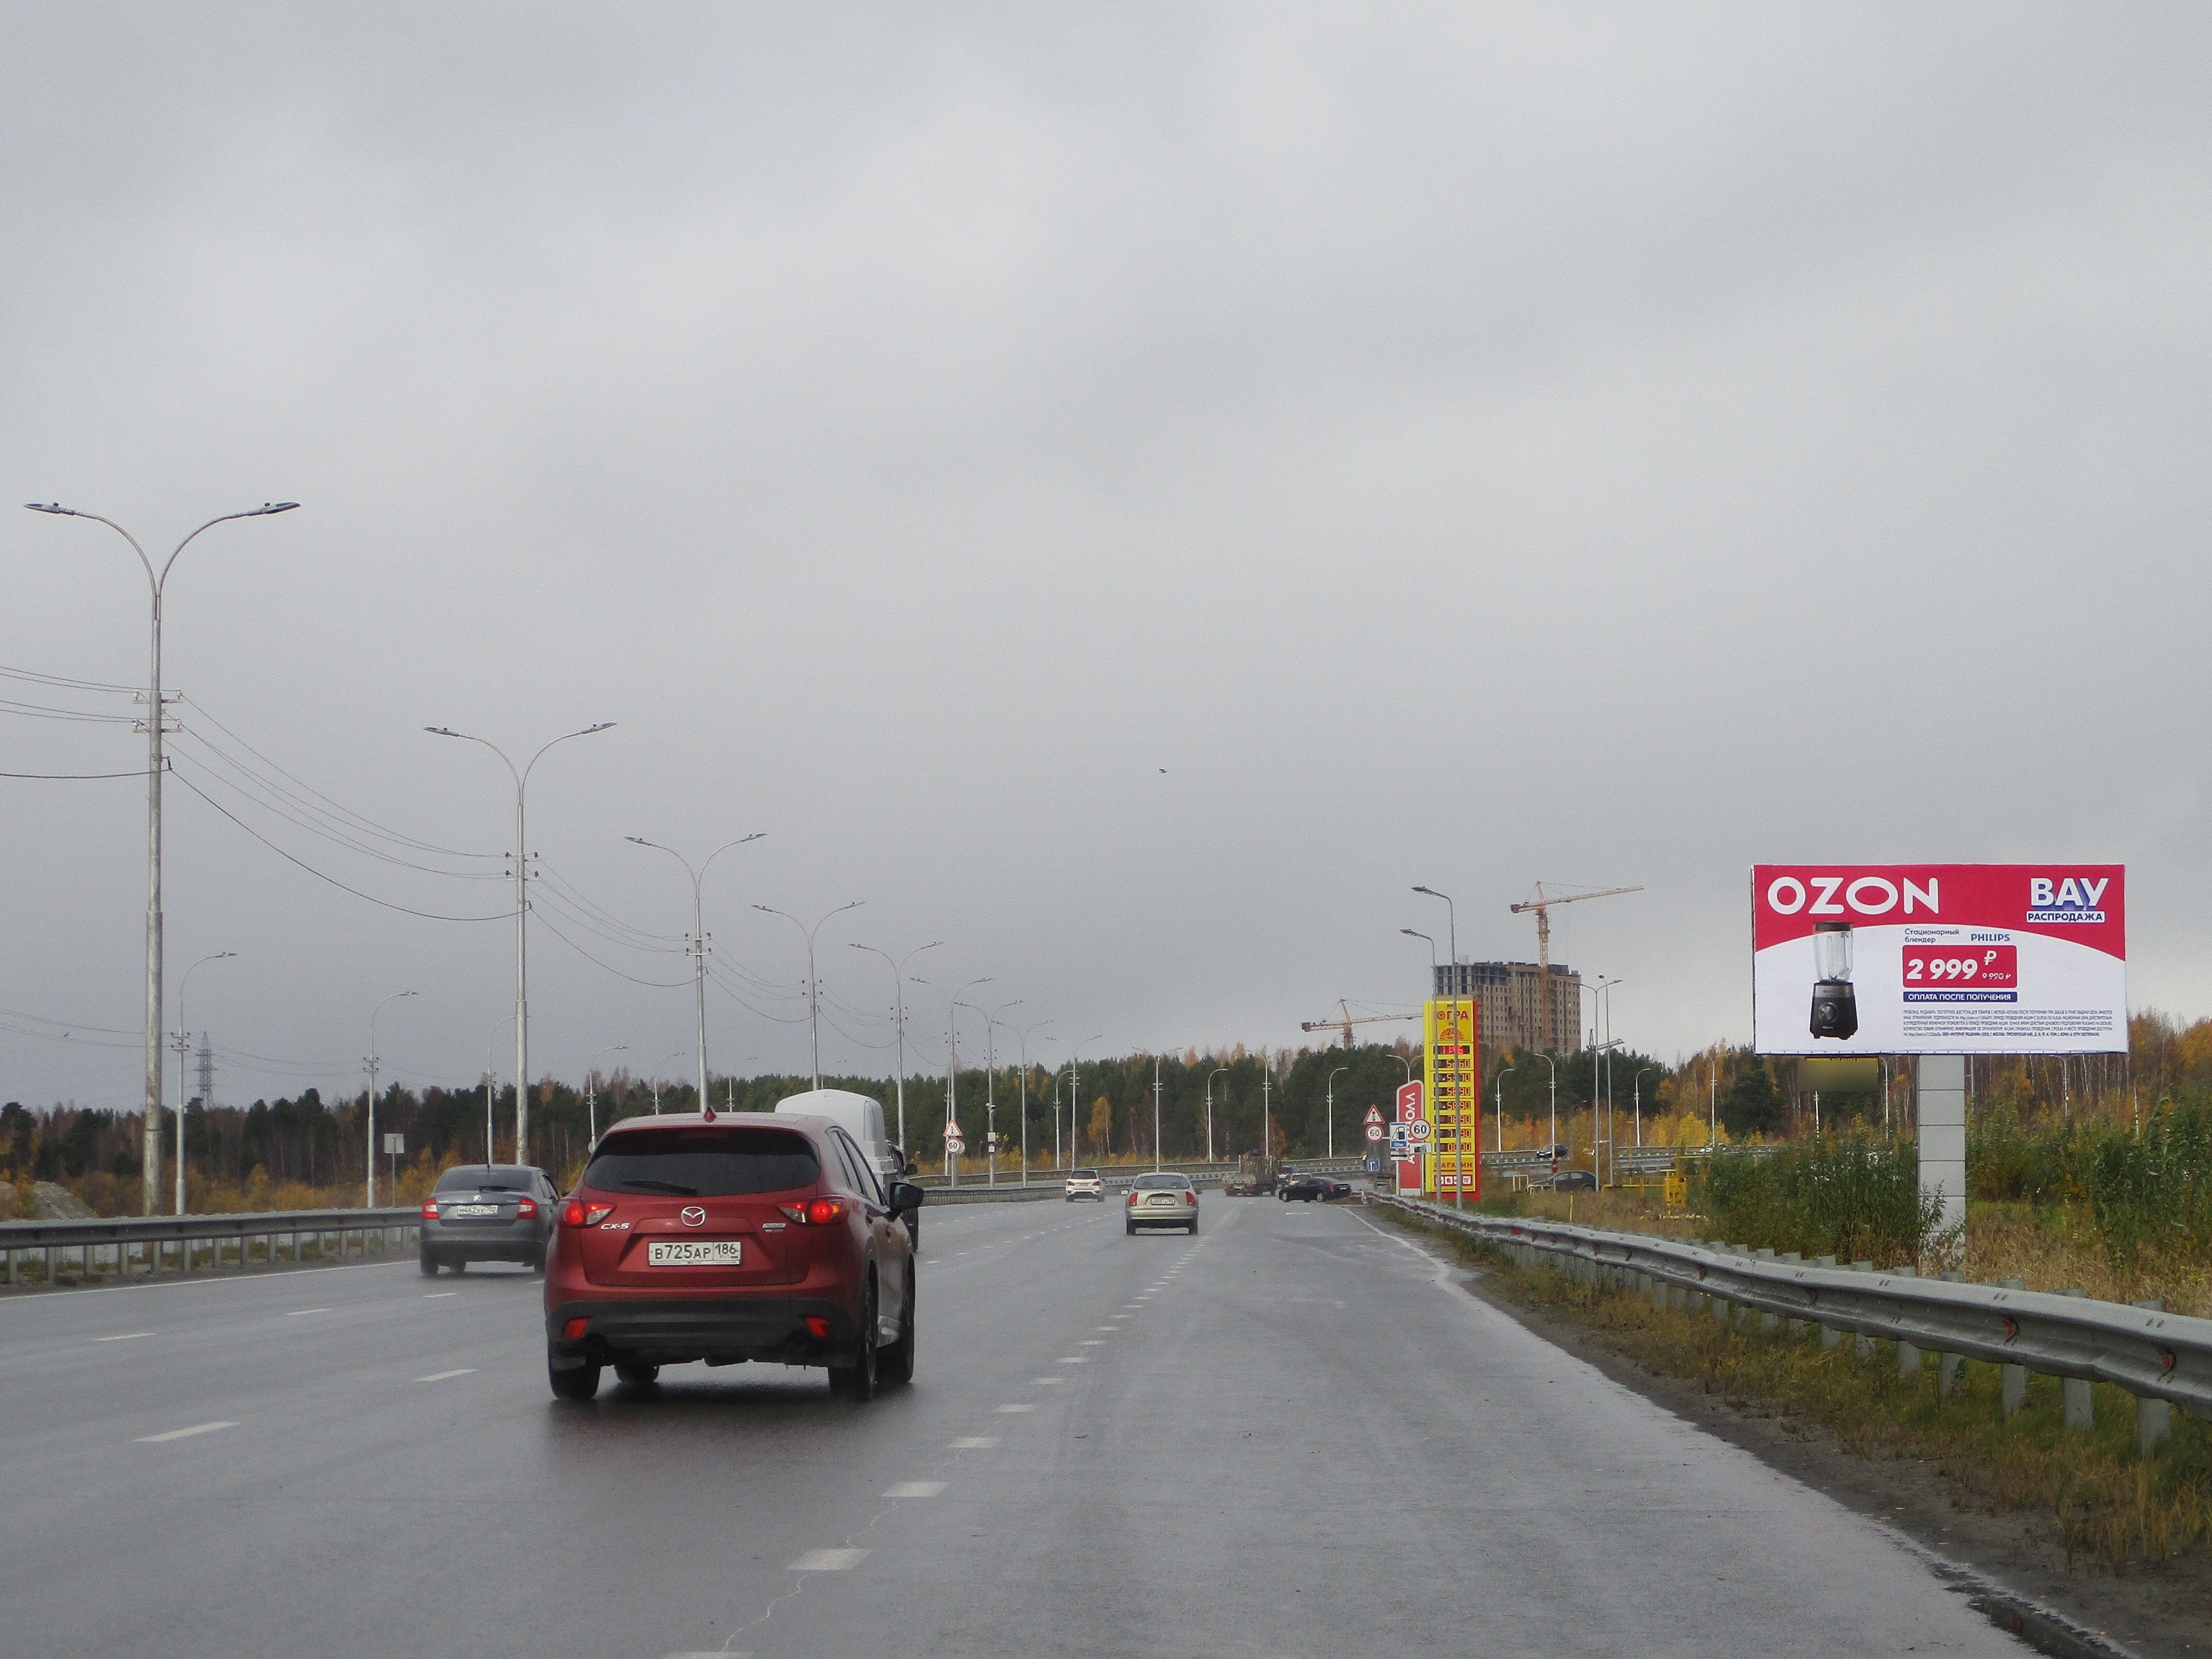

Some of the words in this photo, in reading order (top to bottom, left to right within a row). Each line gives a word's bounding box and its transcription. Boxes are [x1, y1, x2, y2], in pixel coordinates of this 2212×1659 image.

[1767, 876, 1939, 914] OZON
[2028, 913, 2102, 922] РАСПРОДАЖА
[1905, 928, 1959, 936] Стационарный
[1413, 1125, 1427, 1134] 60
[655, 1245, 711, 1259] В725АР
[715, 1243, 735, 1255] 186
